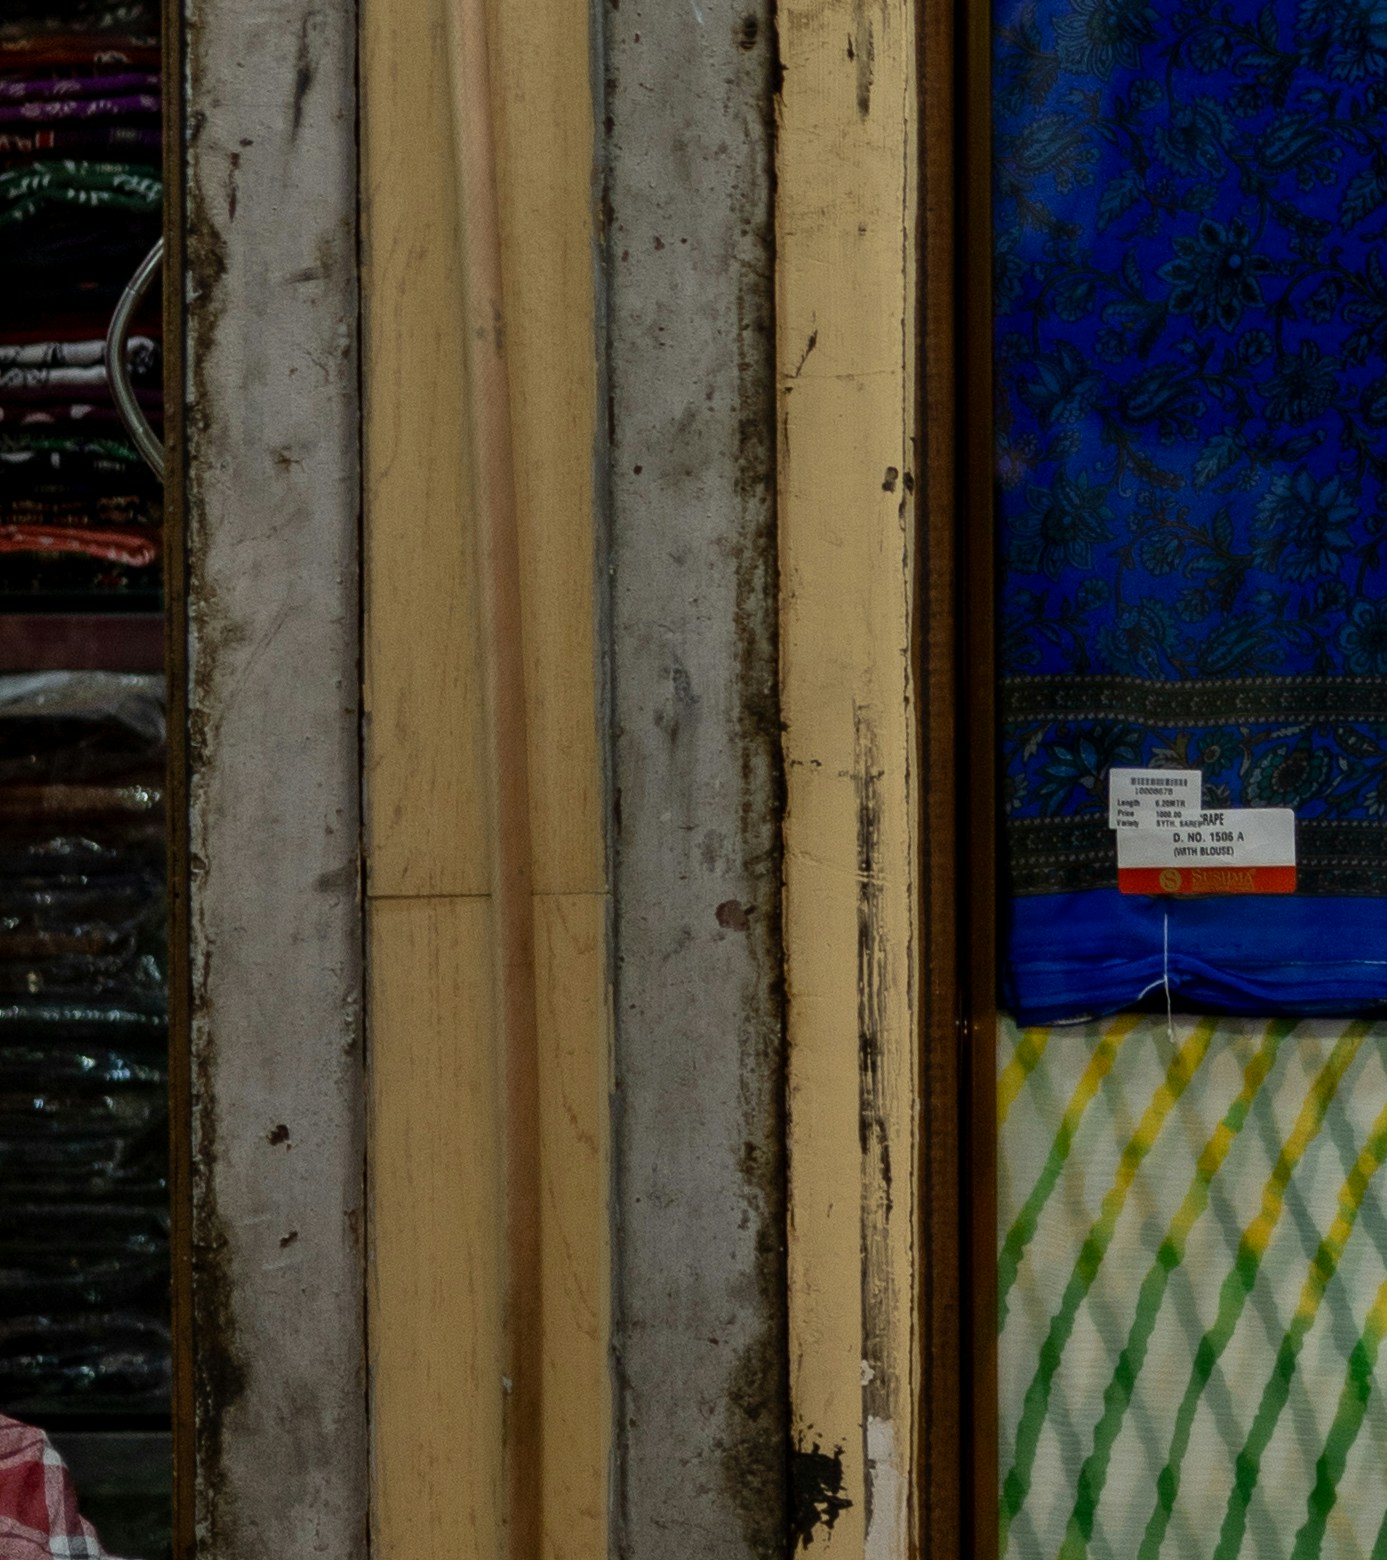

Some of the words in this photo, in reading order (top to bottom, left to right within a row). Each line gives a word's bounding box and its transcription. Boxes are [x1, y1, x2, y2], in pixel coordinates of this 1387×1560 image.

[1117, 799, 1140, 808] Length
[1116, 820, 1139, 828] Variety
[1200, 813, 1224, 826] RAPE
[1173, 833, 1183, 843] D.
[1187, 833, 1205, 842] NO.
[1237, 832, 1244, 841] A
[1200, 846, 1234, 857] BLOUSE)
